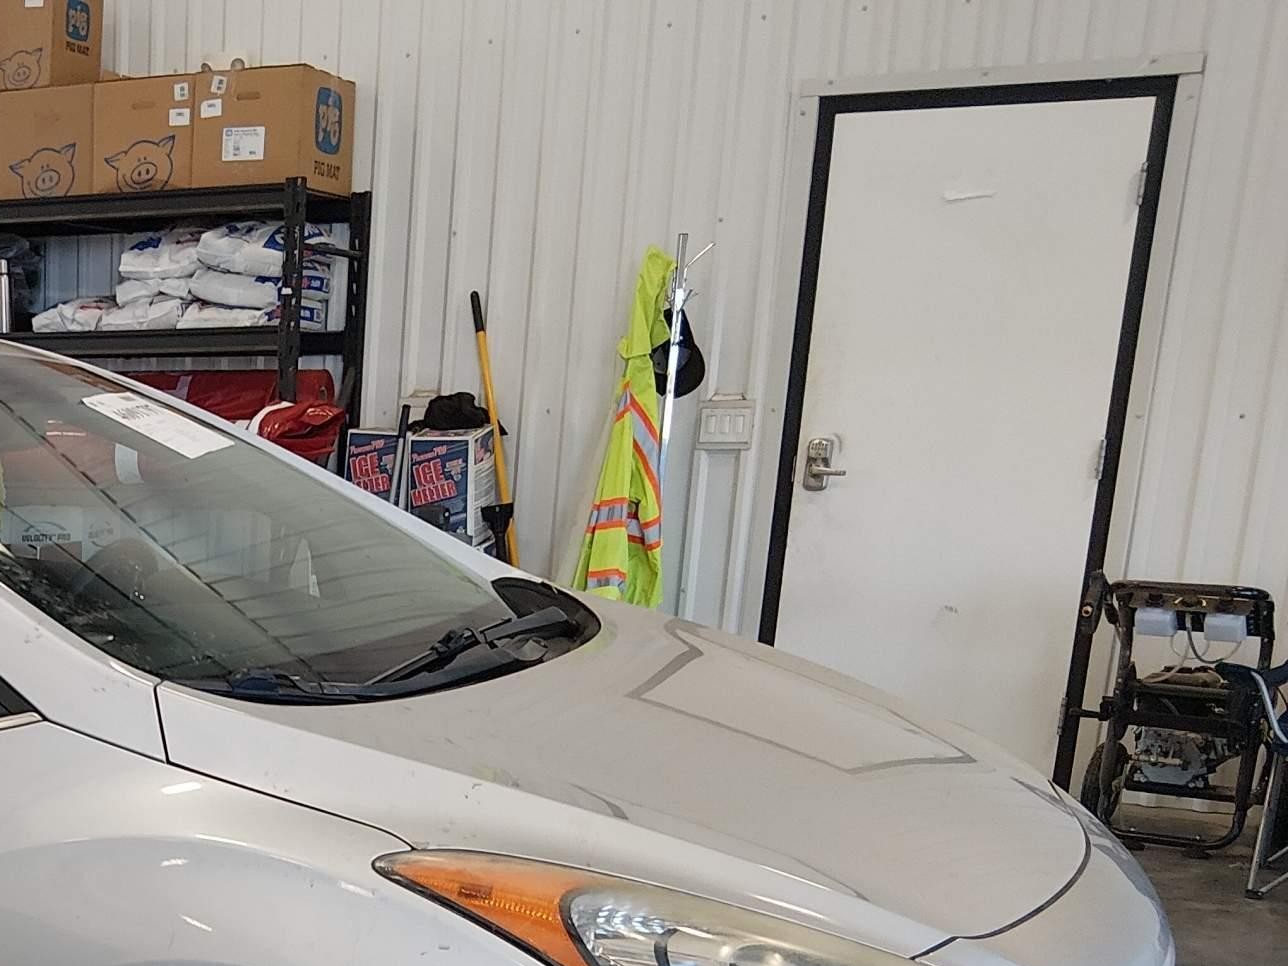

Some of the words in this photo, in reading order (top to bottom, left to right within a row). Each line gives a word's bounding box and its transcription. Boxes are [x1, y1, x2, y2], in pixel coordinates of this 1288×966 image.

[68, 5, 88, 36] pig
[313, 160, 325, 177] PIG
[326, 162, 341, 181] MAT
[349, 451, 380, 482] ICE
[413, 459, 445, 489] ICE
[353, 473, 391, 493] ELTER
[411, 480, 458, 506] MELTER
